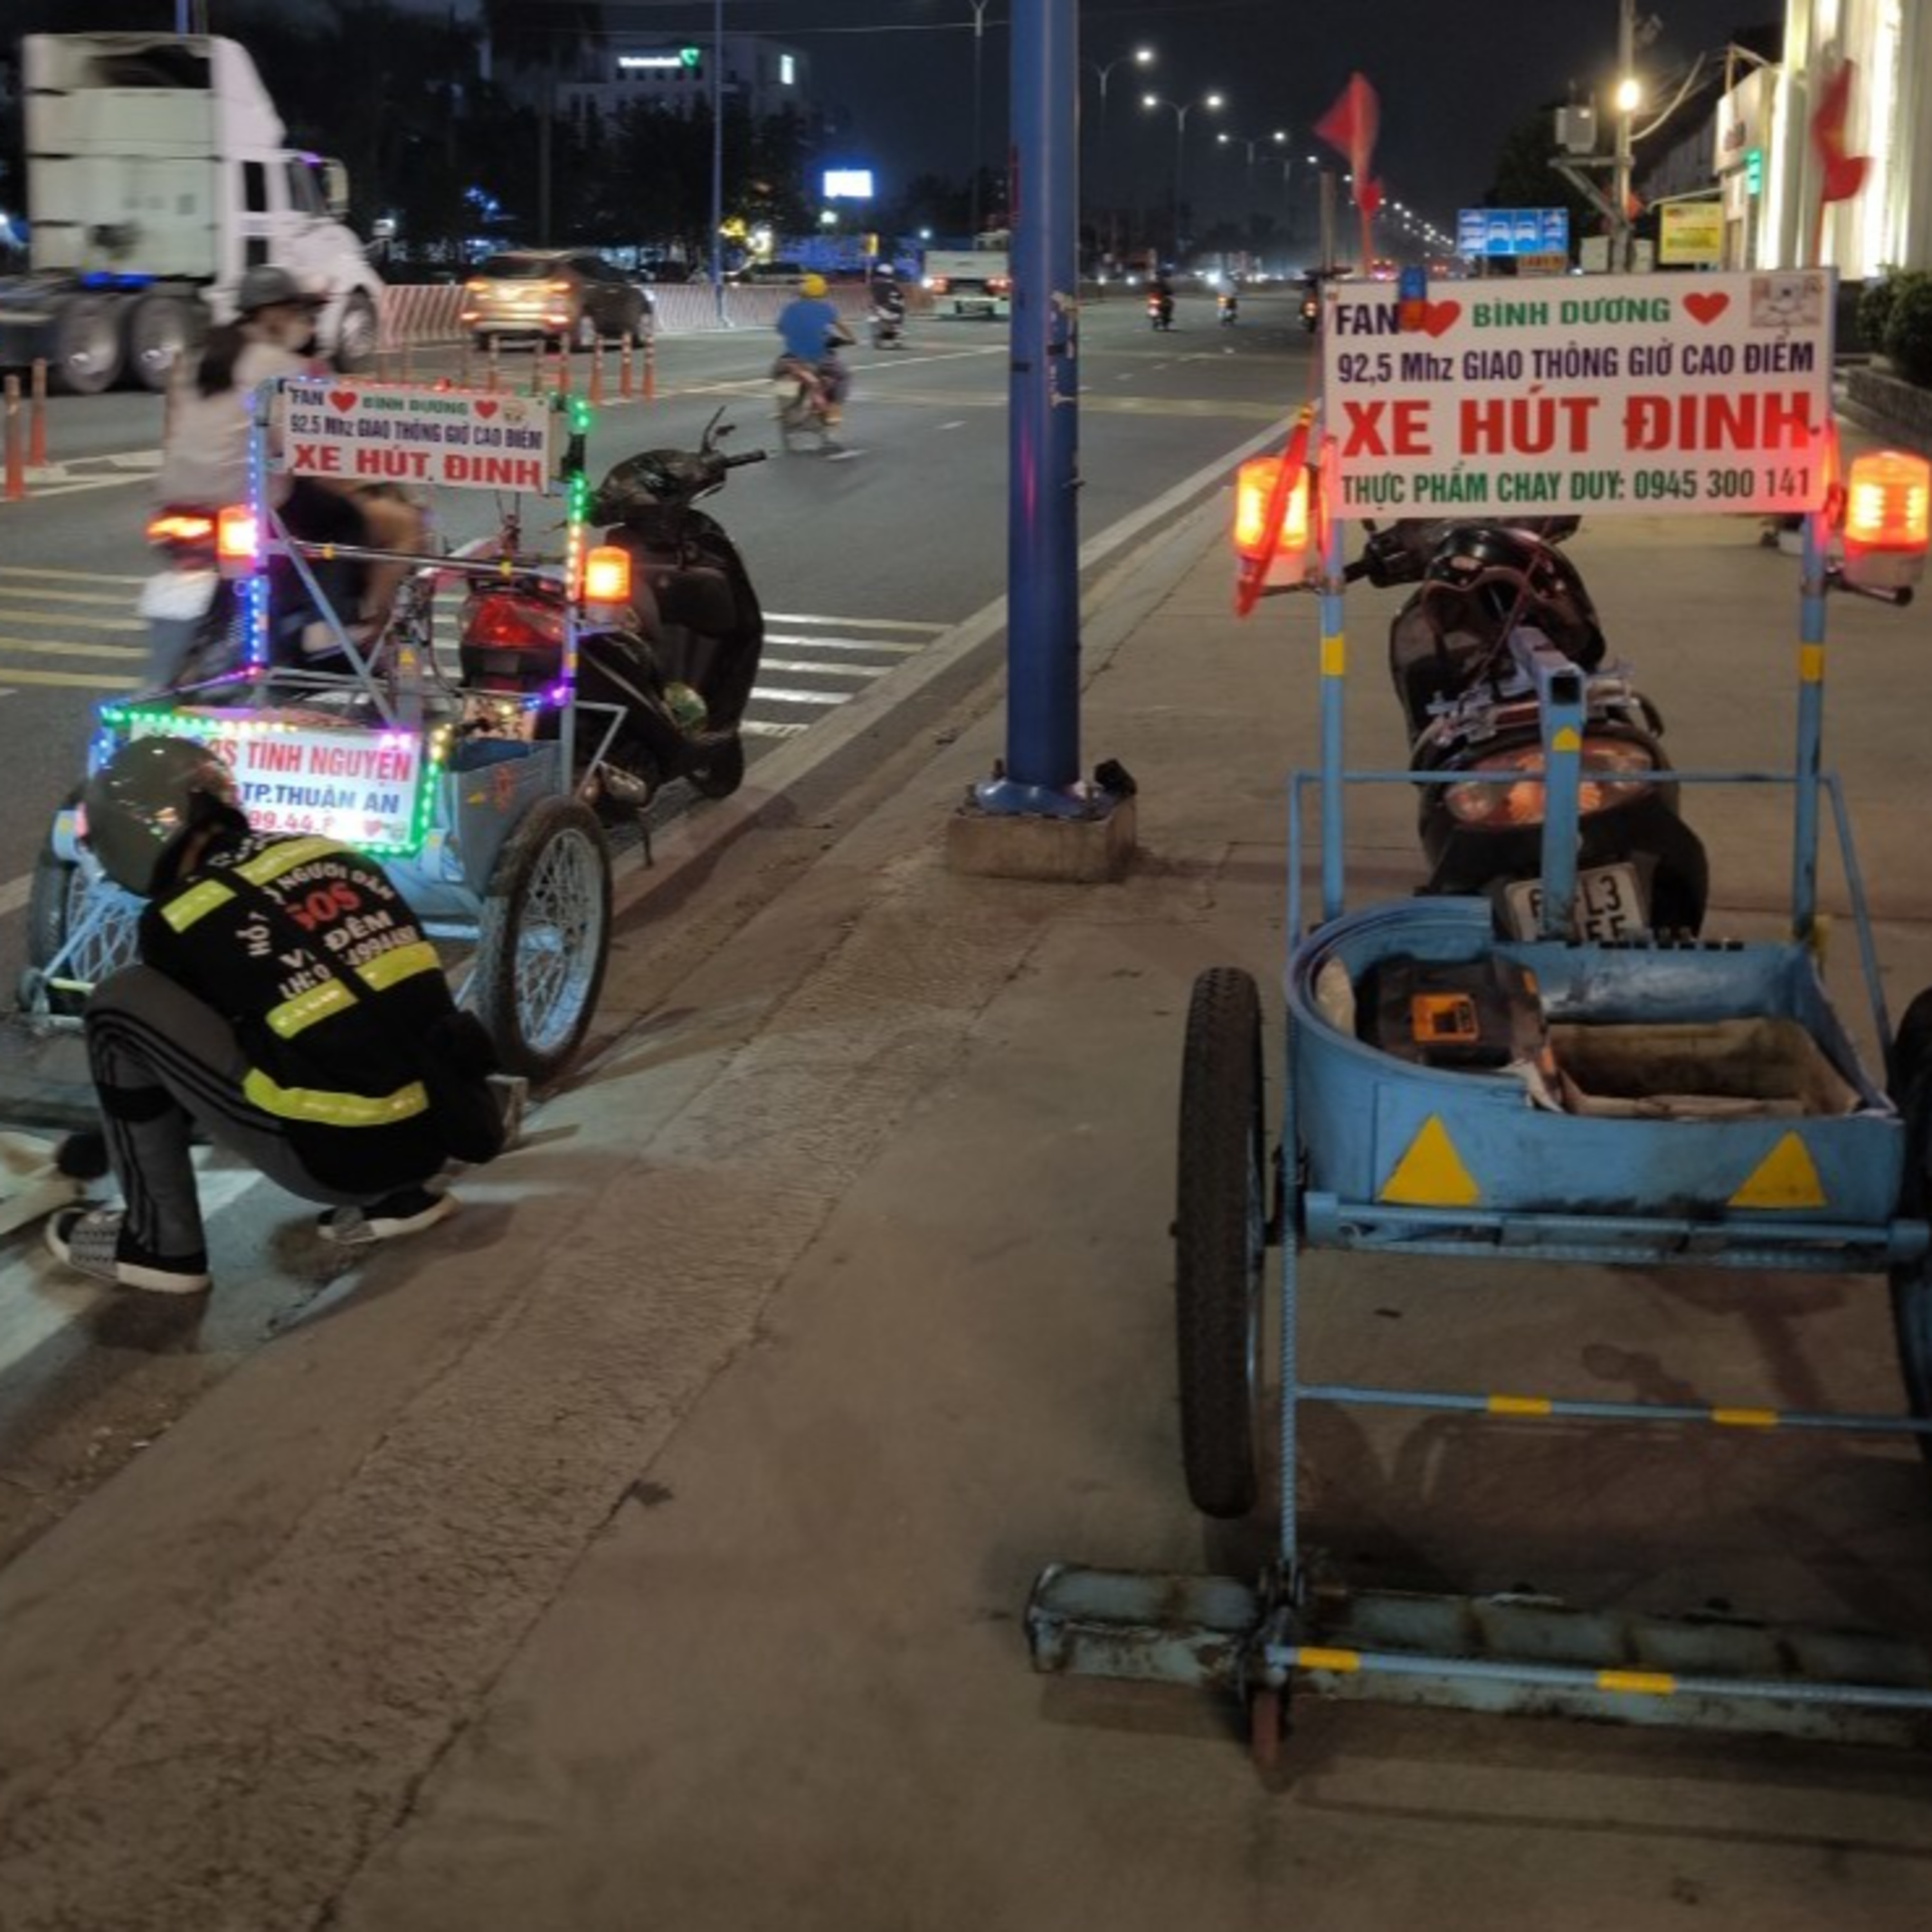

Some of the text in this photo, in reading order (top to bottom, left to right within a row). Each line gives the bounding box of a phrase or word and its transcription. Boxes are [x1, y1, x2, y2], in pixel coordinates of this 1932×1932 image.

[1335, 295, 1671, 336] FAN BÌNH DƯƠNG
[1338, 352, 1392, 386] 92,5
[1400, 352, 1454, 383] Mhz
[1463, 349, 1524, 381] GIAO
[1531, 339, 1619, 379] THÔNG
[1627, 336, 1674, 377] GIỜ
[1681, 344, 1735, 376] CAO
[1341, 384, 1810, 457] XE HÚT ĐINH
[294, 443, 541, 485] XE HÚT ĐINH
[1497, 471, 1562, 503] CHAY
[1569, 470, 1625, 501] DUY:
[1634, 469, 1698, 500] 0945
[1706, 468, 1755, 499] 300
[1765, 468, 1810, 498] 141
[362, 791, 401, 814] AN
